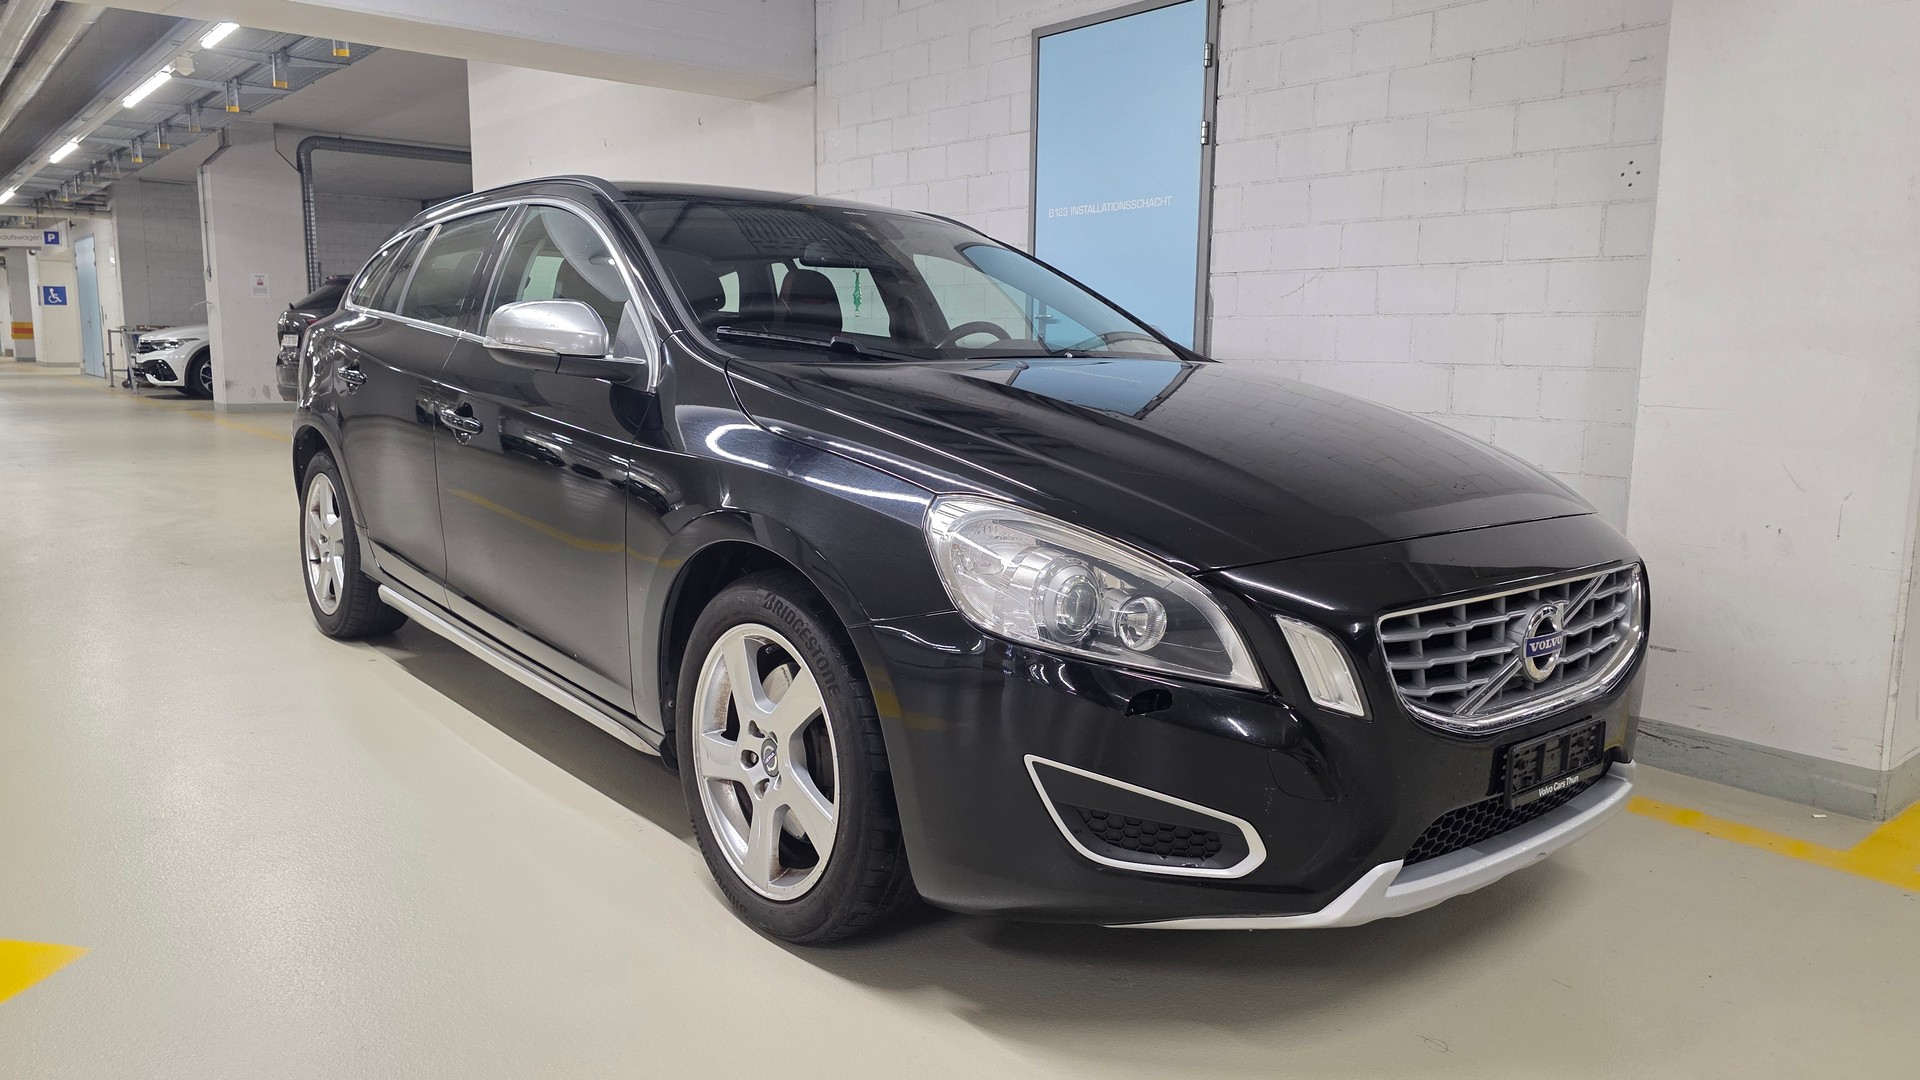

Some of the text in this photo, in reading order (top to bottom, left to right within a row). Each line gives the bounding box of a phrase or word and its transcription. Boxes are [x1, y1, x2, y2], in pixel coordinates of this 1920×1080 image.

[1070, 195, 1173, 216] INSTALLATIONSSCHACHT
[48, 233, 56, 242] P
[762, 592, 841, 697] BRIDGESTONE
[1529, 635, 1562, 652] VOLVO
[1538, 775, 1579, 797] Volvo Cars Thun
